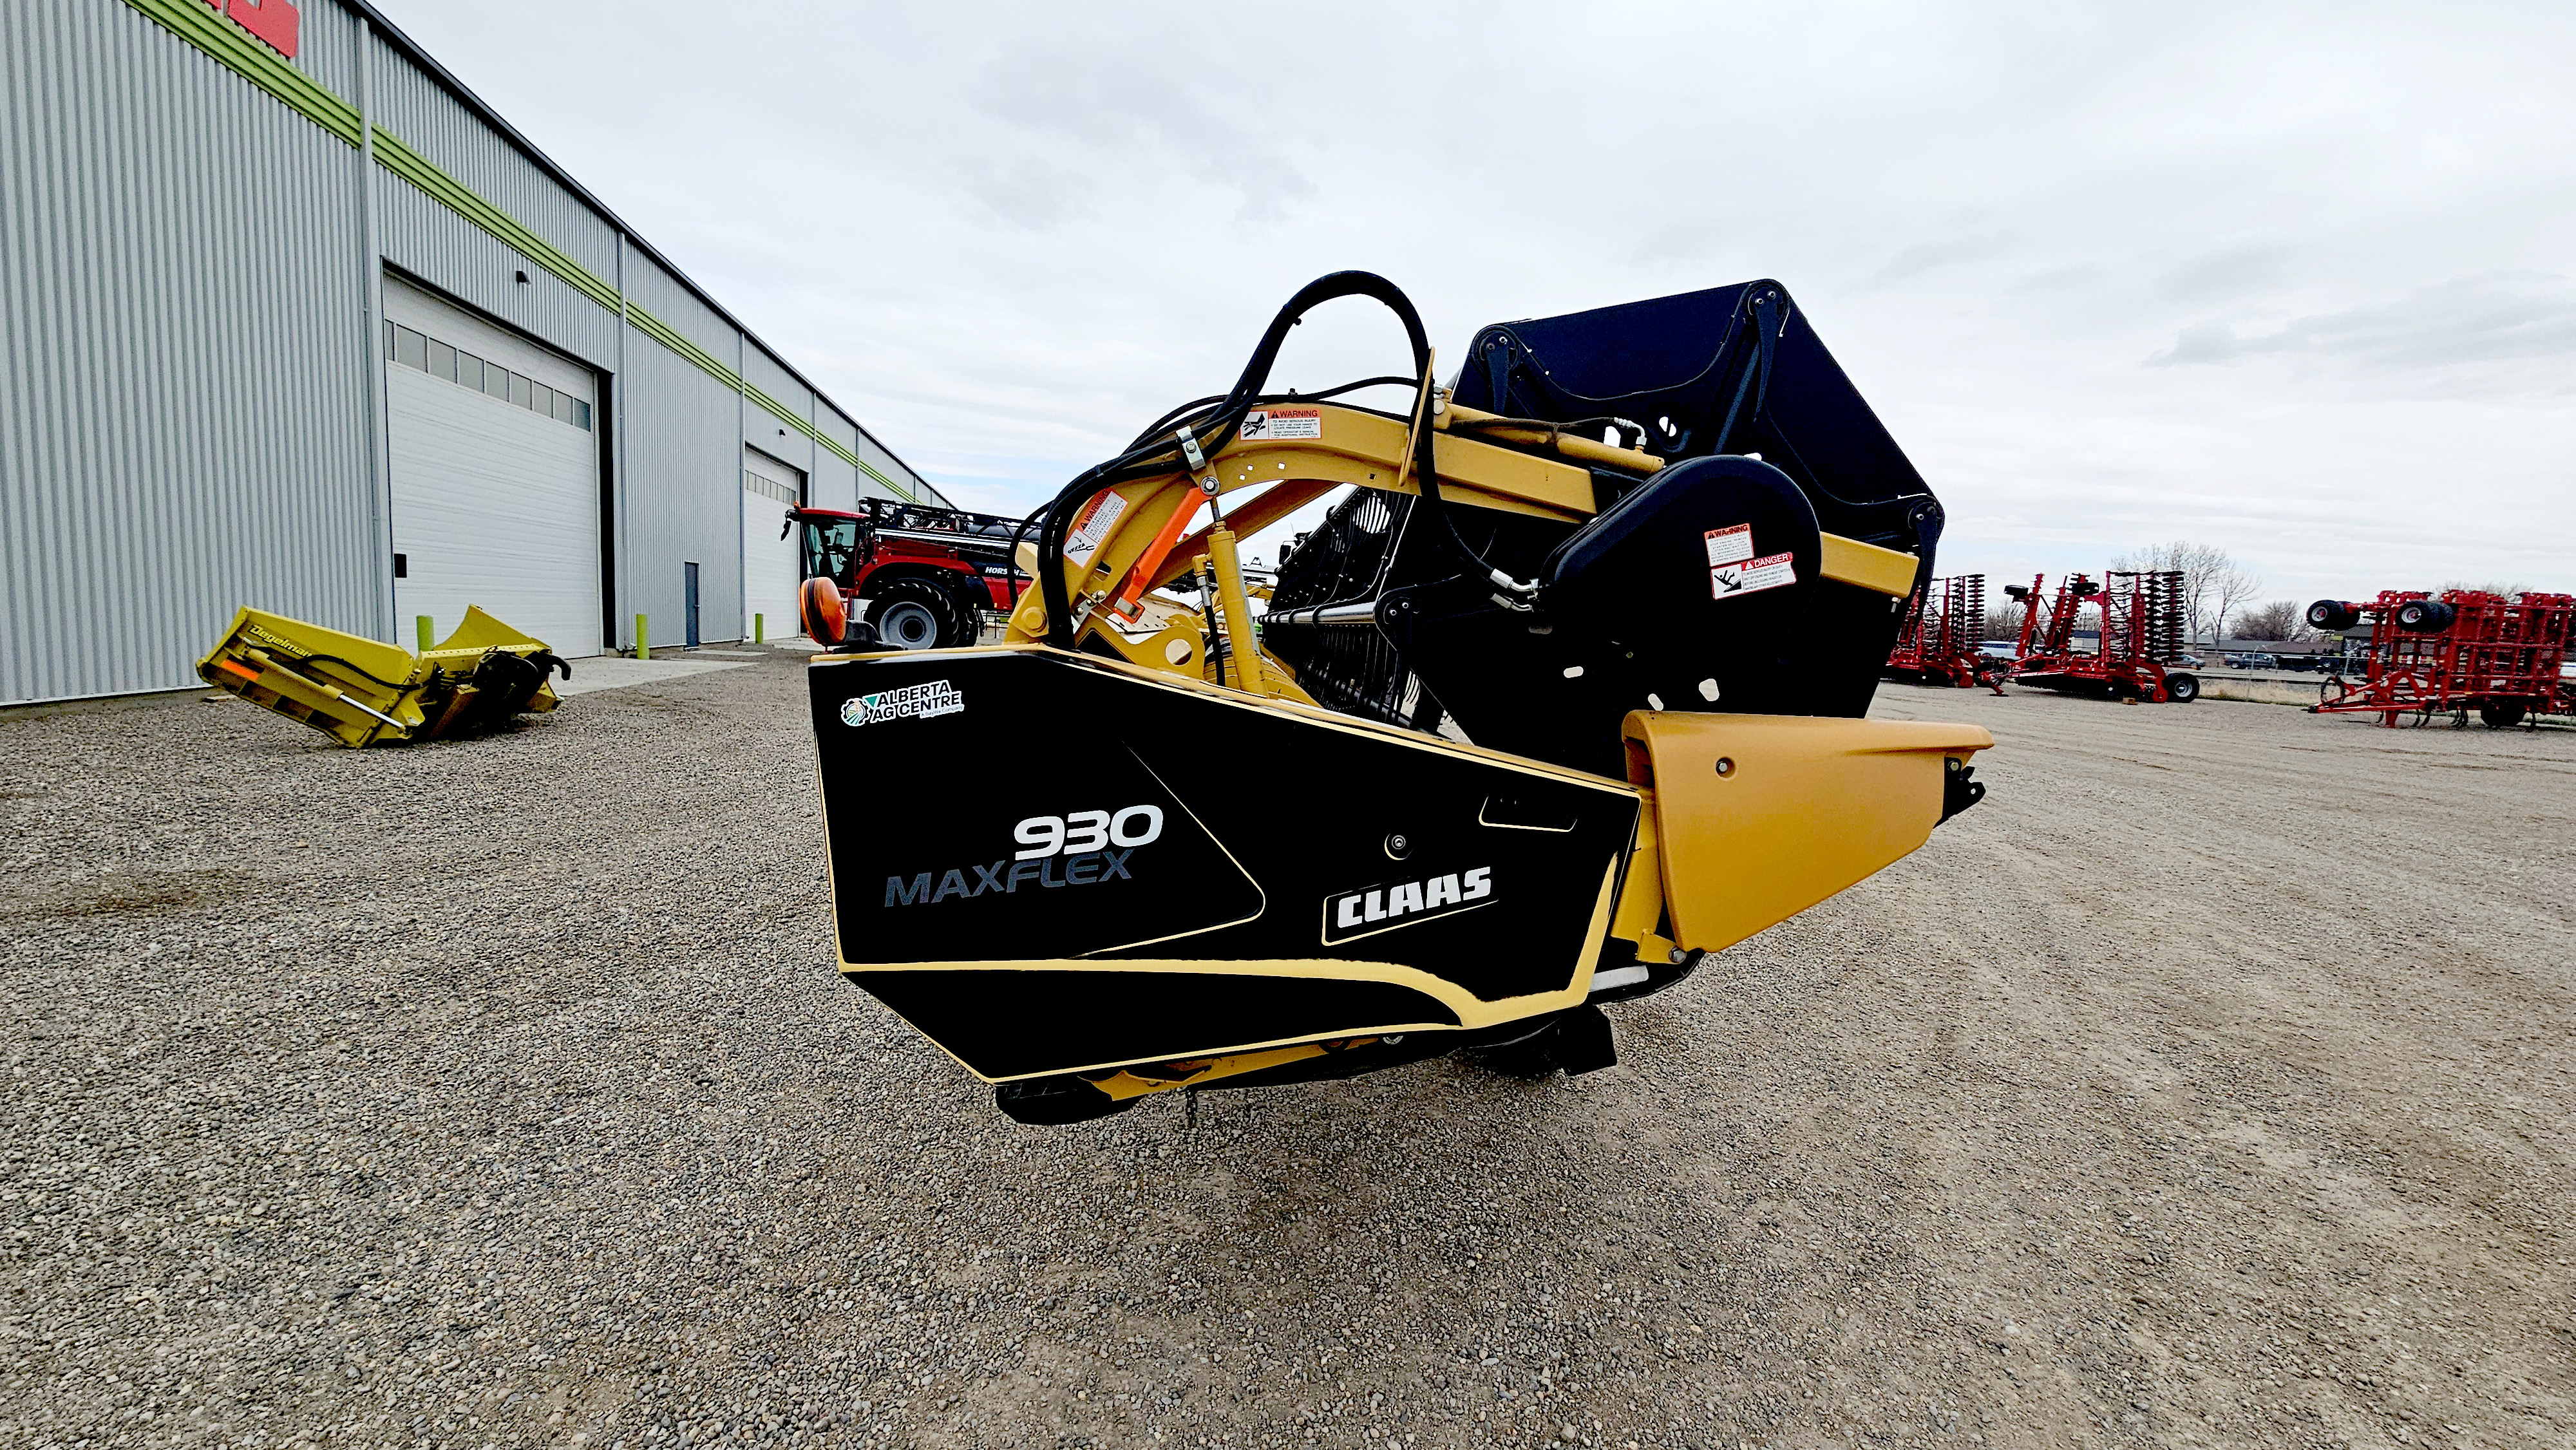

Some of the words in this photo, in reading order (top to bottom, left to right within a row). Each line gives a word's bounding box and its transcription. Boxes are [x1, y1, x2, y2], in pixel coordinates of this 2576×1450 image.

[1084, 489, 1108, 522] WARNING
[1714, 525, 1748, 536] WARNING
[985, 567, 1019, 576] HORSH
[1754, 553, 1788, 568] DANGER
[248, 625, 312, 657] Degelman
[871, 706, 895, 722] AG
[898, 693, 960, 715] CENTRE
[876, 681, 950, 708] ALBERTA
[1014, 804, 1164, 860] 930
[884, 848, 1135, 908] MAXFLEX
[1338, 866, 1491, 928] CLAAS
